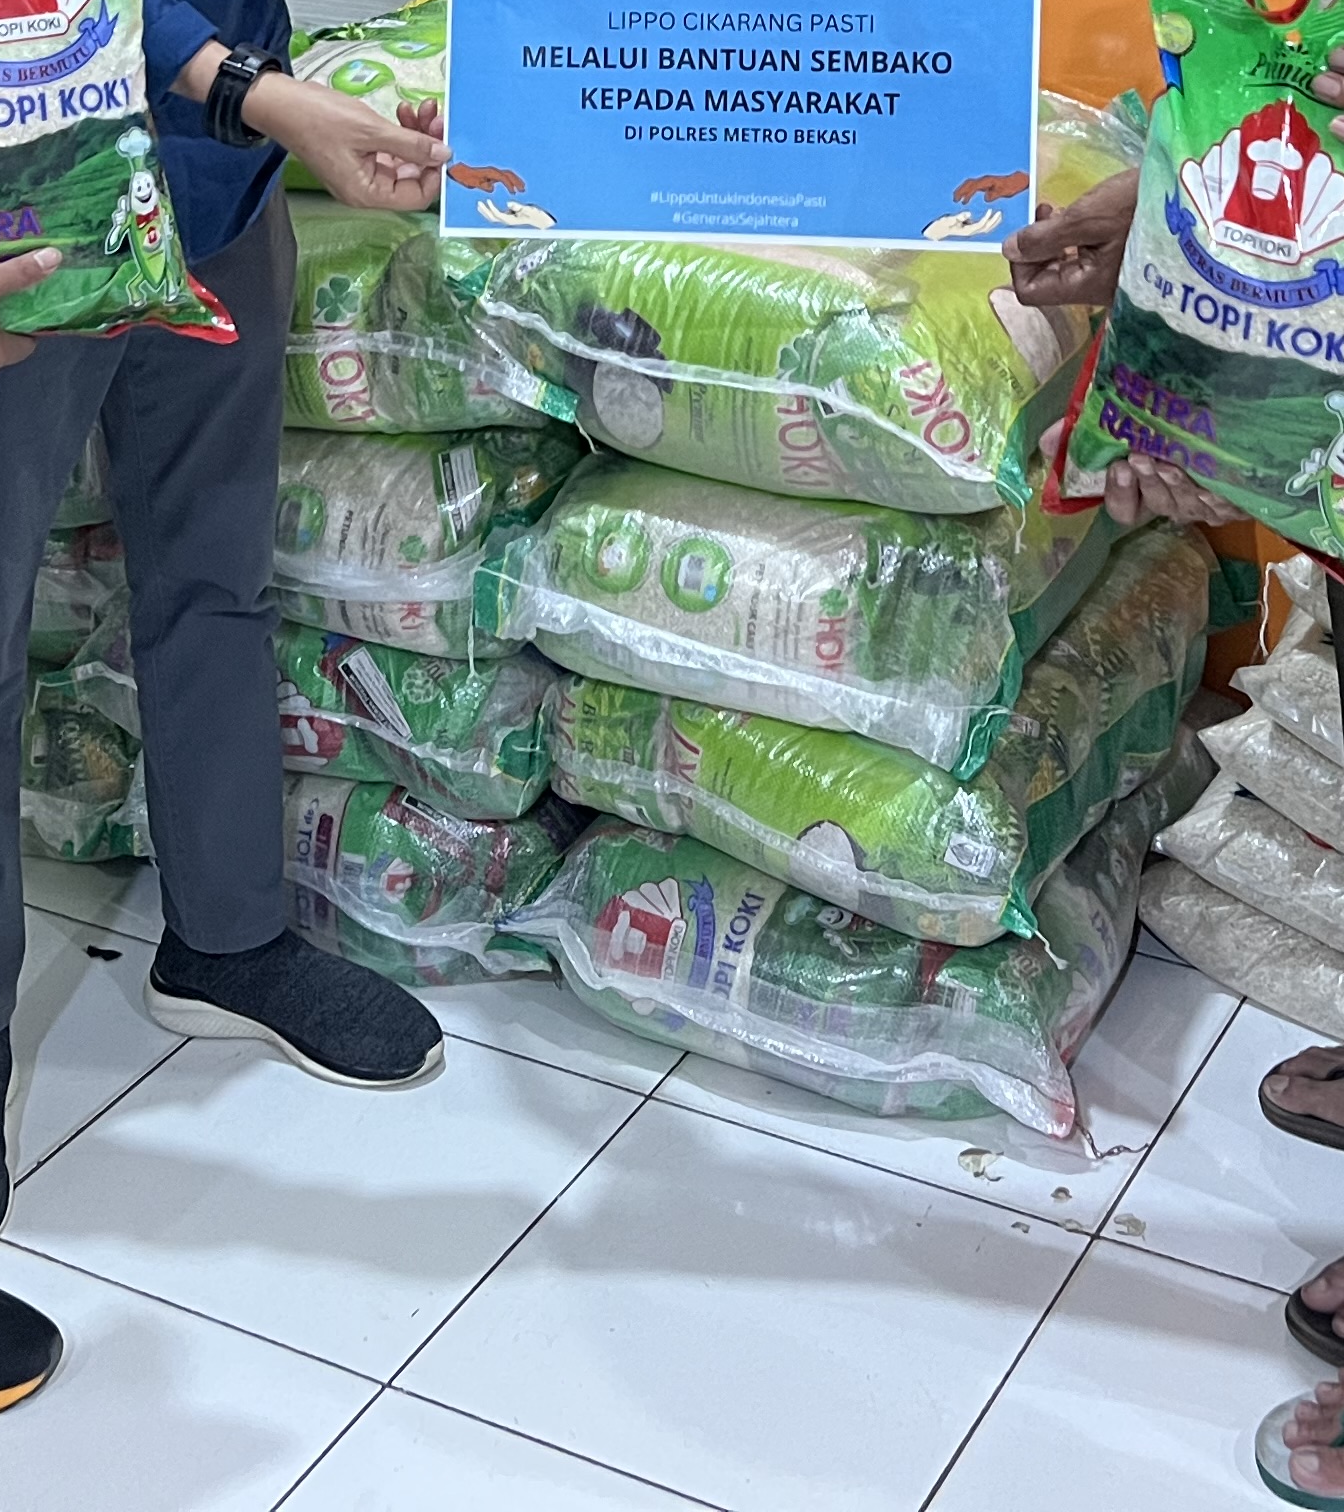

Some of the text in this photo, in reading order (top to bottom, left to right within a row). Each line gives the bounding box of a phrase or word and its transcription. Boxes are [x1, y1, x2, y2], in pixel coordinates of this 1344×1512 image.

[28, 17, 61, 33] KOKI
[608, 11, 875, 34] LIPPO CIKARANG PASTI
[18, 45, 92, 82] BERMUTU
[522, 45, 953, 74] MELALUI BANTUAN SEMBAKO
[58, 77, 131, 118] KOKI
[580, 87, 901, 116] KEPADA MASYARAKAT
[624, 126, 857, 145] DI POLRES METRO BEKASI
[650, 191, 827, 208] #LippoUntukIndonesiaPasti
[672, 212, 799, 229] #GenerasiSejahtera
[1223, 225, 1258, 248] TOPI
[1184, 239, 1320, 303] BERAS BERMUTU
[1143, 262, 1173, 299] Cap
[1180, 284, 1253, 340] TOPI
[1112, 362, 1217, 444] SETRA
[721, 891, 766, 955] KOKI
